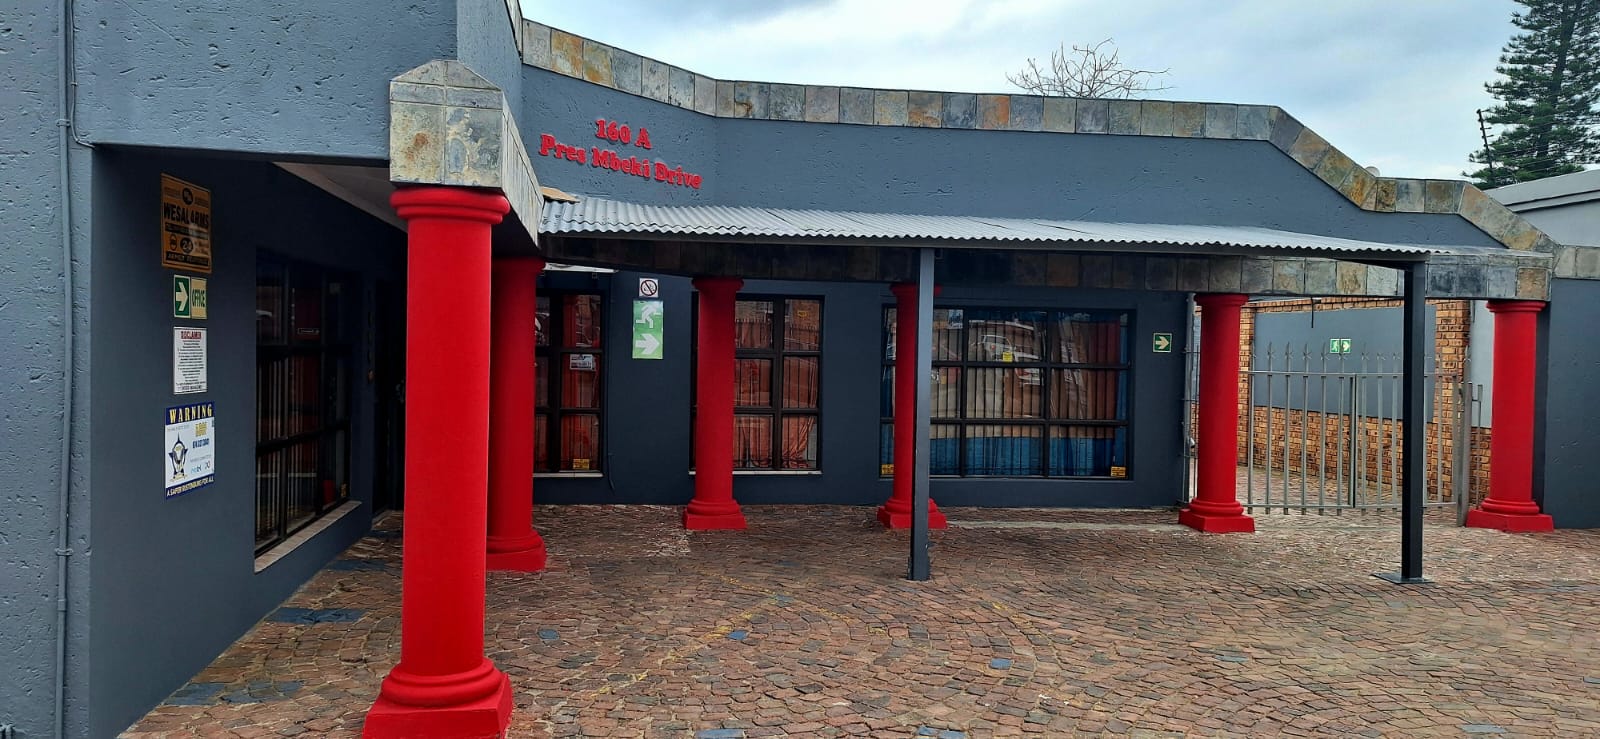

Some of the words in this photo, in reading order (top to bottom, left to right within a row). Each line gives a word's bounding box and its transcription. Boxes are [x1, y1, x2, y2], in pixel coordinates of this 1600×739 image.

[595, 118, 631, 144] 160
[635, 127, 652, 149] A
[539, 133, 587, 164] Pres
[591, 147, 650, 179] Mbeki
[654, 162, 702, 189] Drive
[191, 288, 206, 307] OFFICE
[169, 404, 212, 424] WARNING
